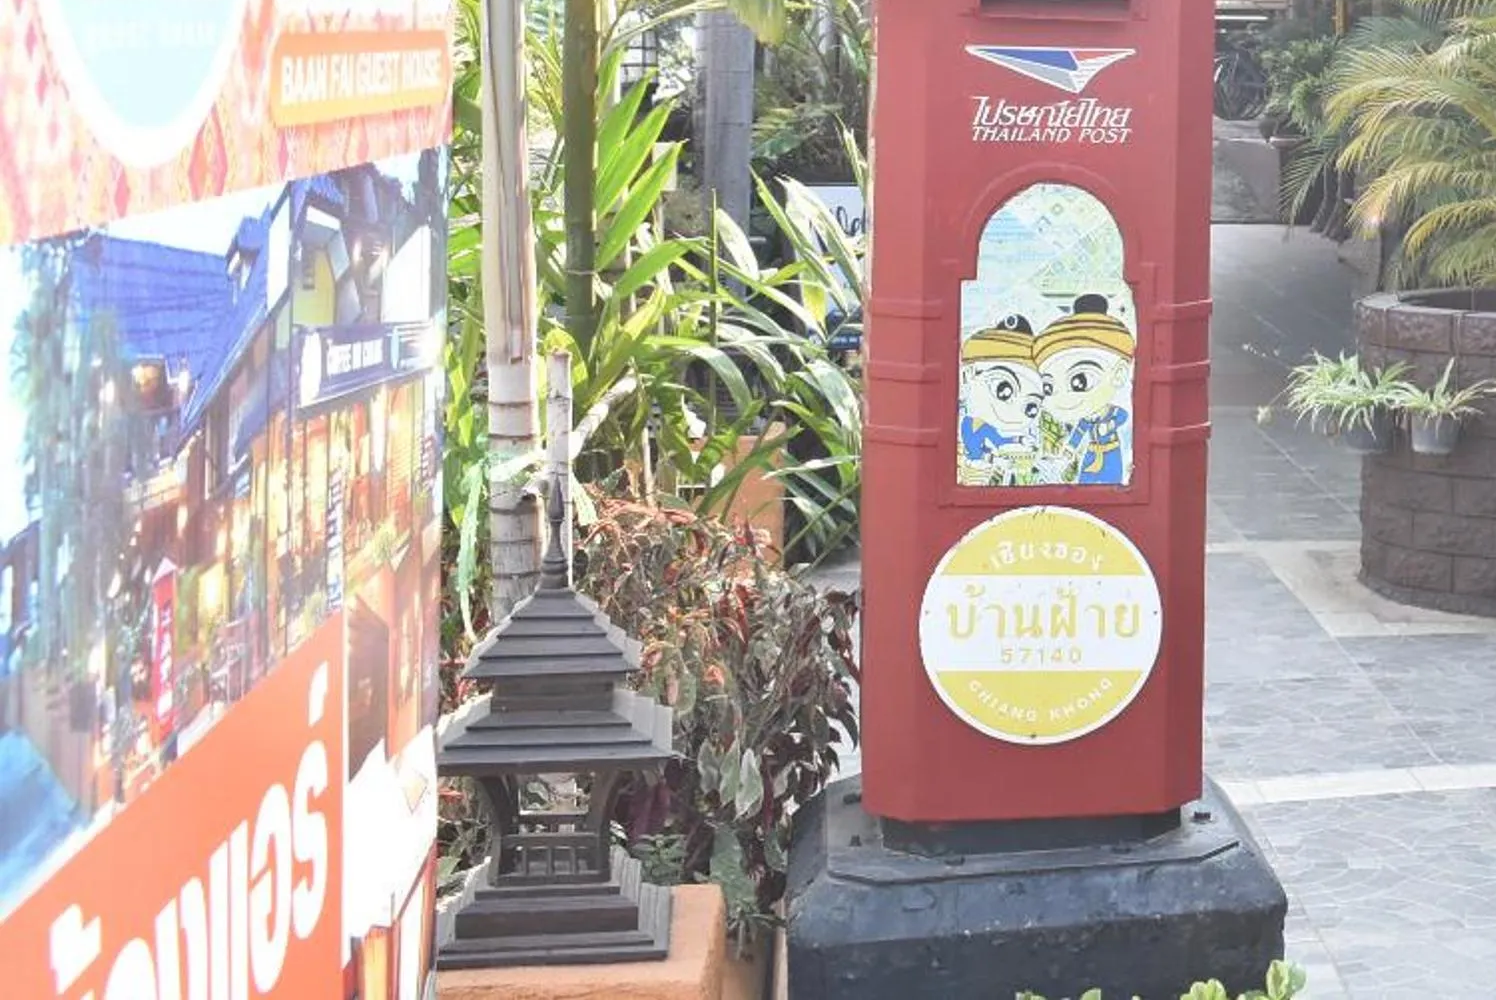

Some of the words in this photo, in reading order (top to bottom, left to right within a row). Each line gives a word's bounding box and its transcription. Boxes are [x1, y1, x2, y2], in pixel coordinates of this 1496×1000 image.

[281, 55, 328, 106] BAAN
[330, 52, 354, 99] FAI
[356, 49, 400, 96] GUEST
[971, 126, 1072, 143] THAILAND
[1078, 127, 1133, 144] POST
[944, 583, 1144, 640] บ้านฝ้าย
[1000, 646, 1084, 665] 57140
[968, 678, 1038, 722] CHIANG
